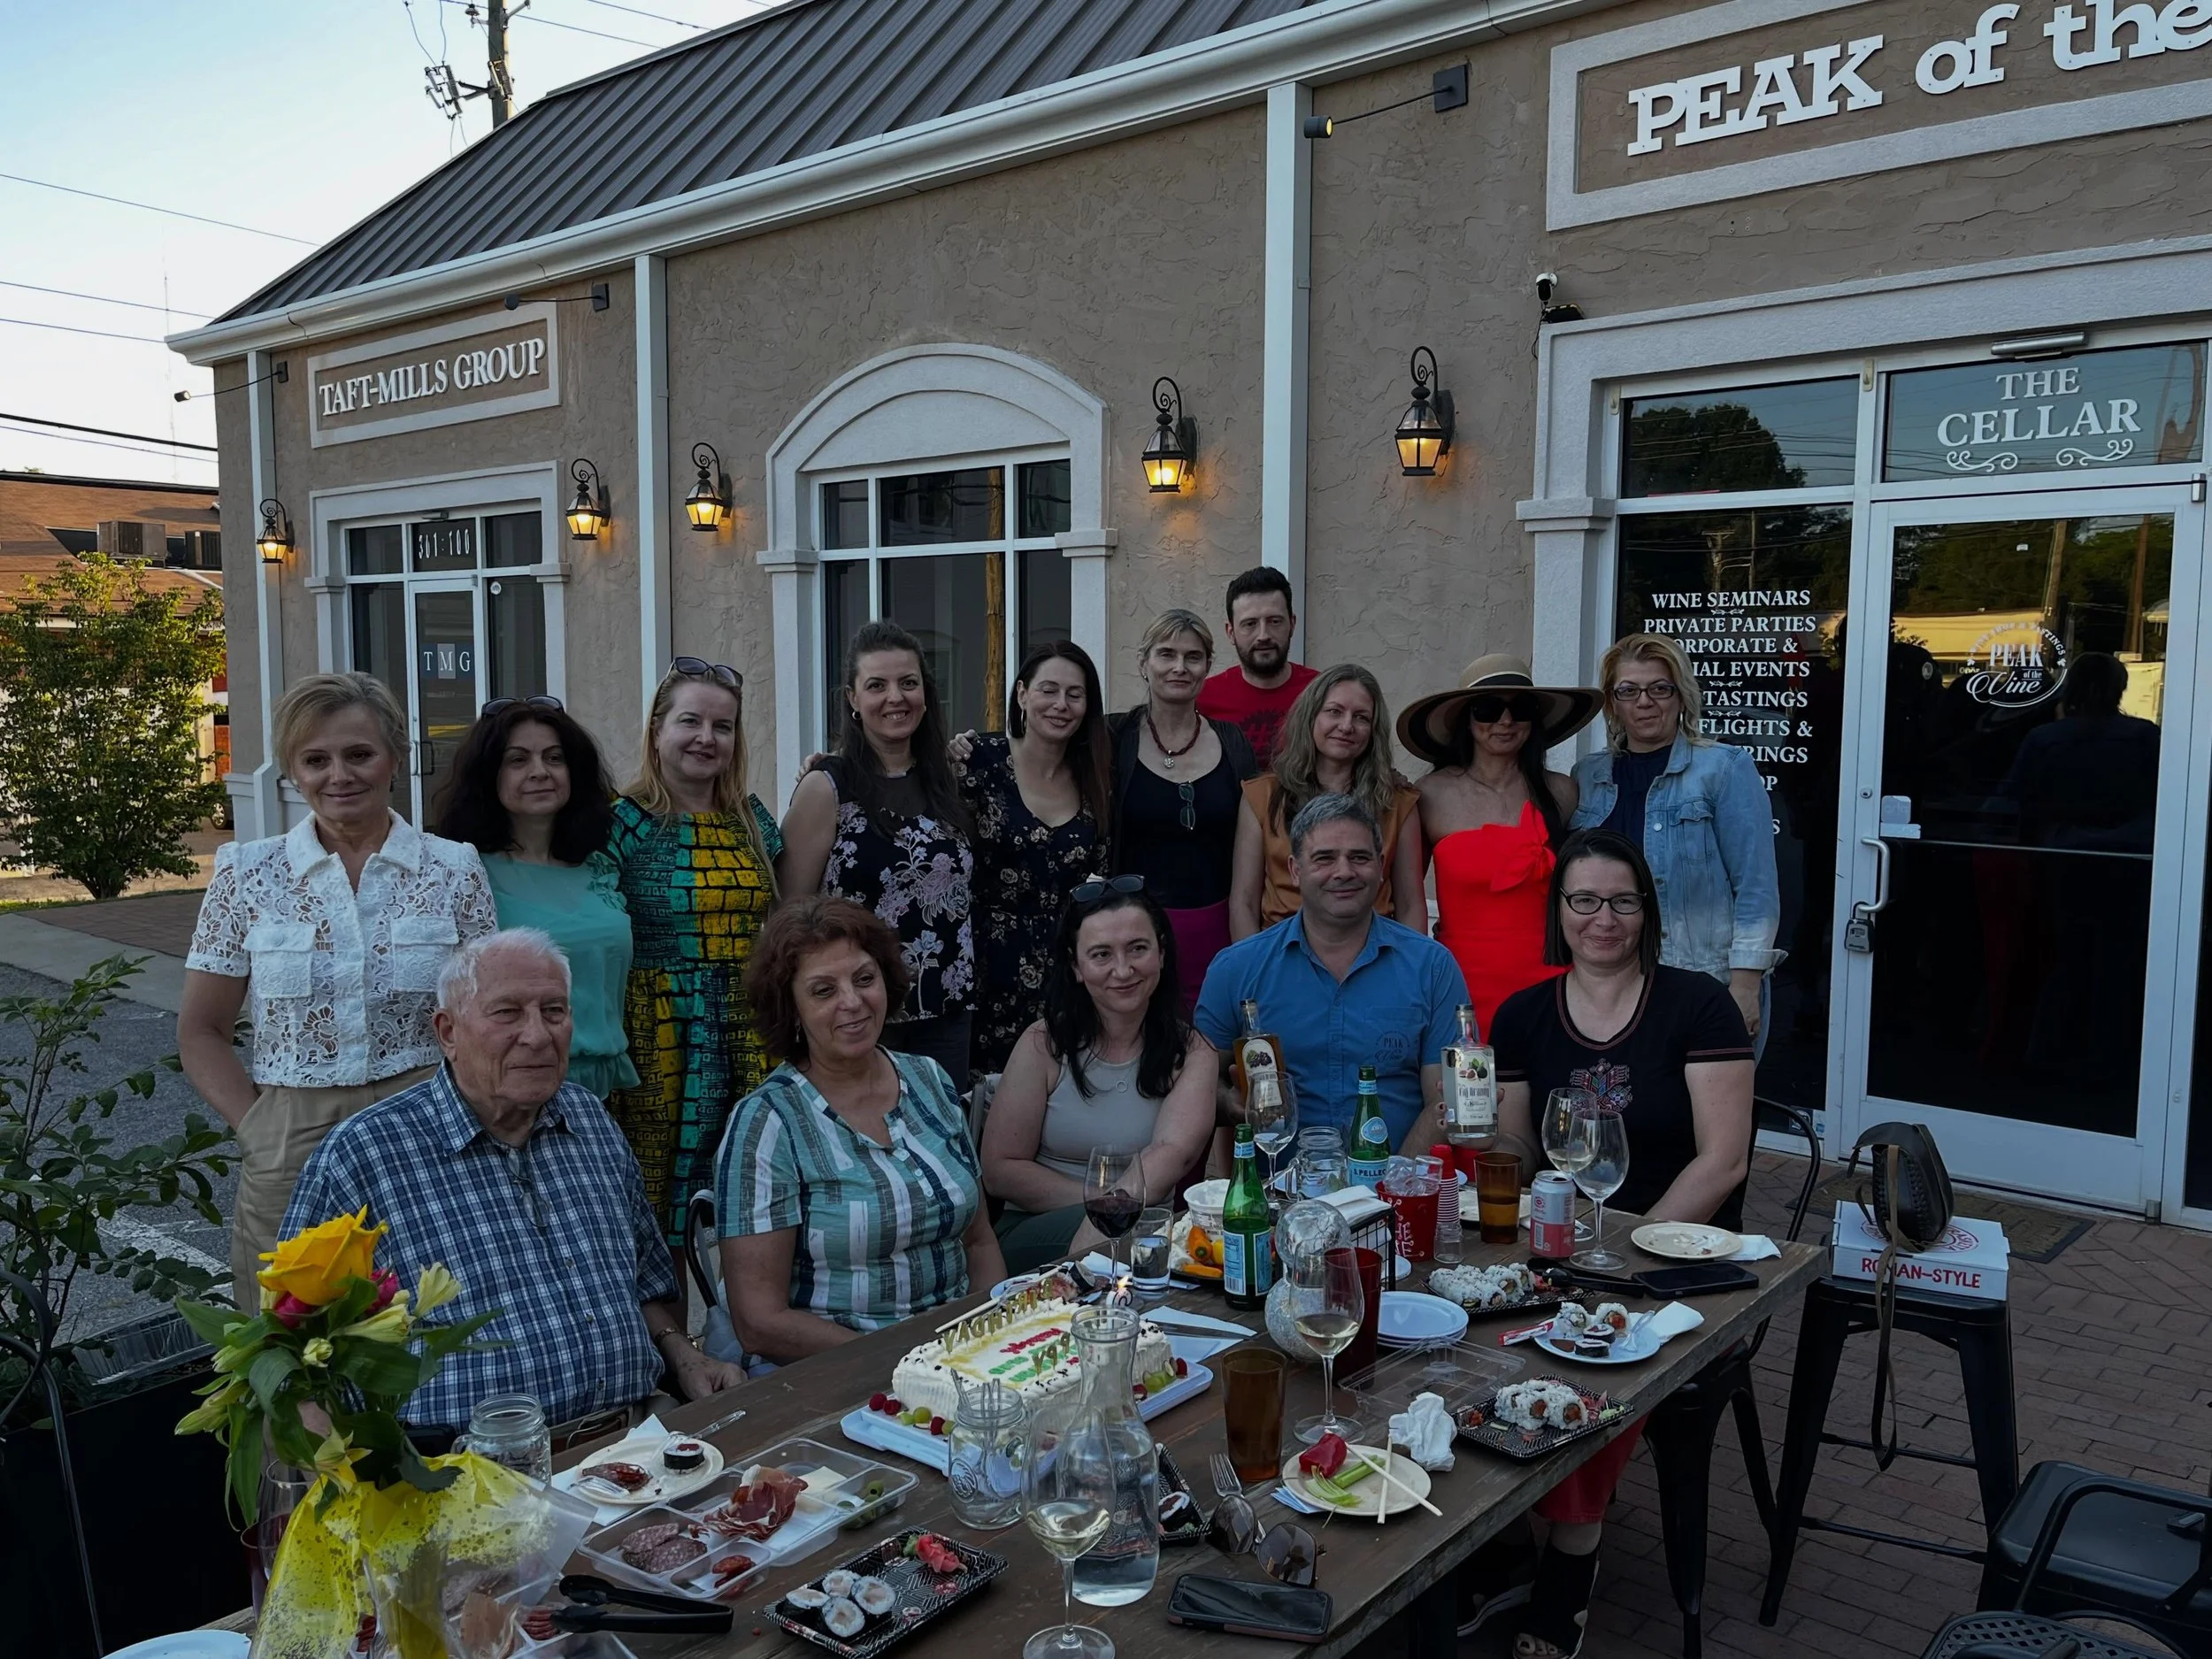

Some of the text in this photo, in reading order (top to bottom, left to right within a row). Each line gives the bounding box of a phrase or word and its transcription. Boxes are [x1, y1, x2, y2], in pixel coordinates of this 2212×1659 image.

[1627, 0, 2212, 157] PEAK of the
[319, 337, 546, 416] TAFT-MILLS GROUP
[1996, 367, 2081, 402] THE
[1937, 398, 2143, 448] CELLAR
[1652, 590, 1811, 609] WINE SEMINARS
[1644, 617, 1816, 634] PRIVATE PARTIES
[1673, 637, 1798, 653] ORPORATE &
[1989, 643, 2044, 666] PEAK
[1730, 662, 1810, 678] EVENTS
[1966, 671, 2042, 703] Vine
[1703, 691, 1808, 708] TASTINGS
[1698, 718, 1813, 737] FLIGHTS &
[1740, 747, 1808, 764] RINGS
